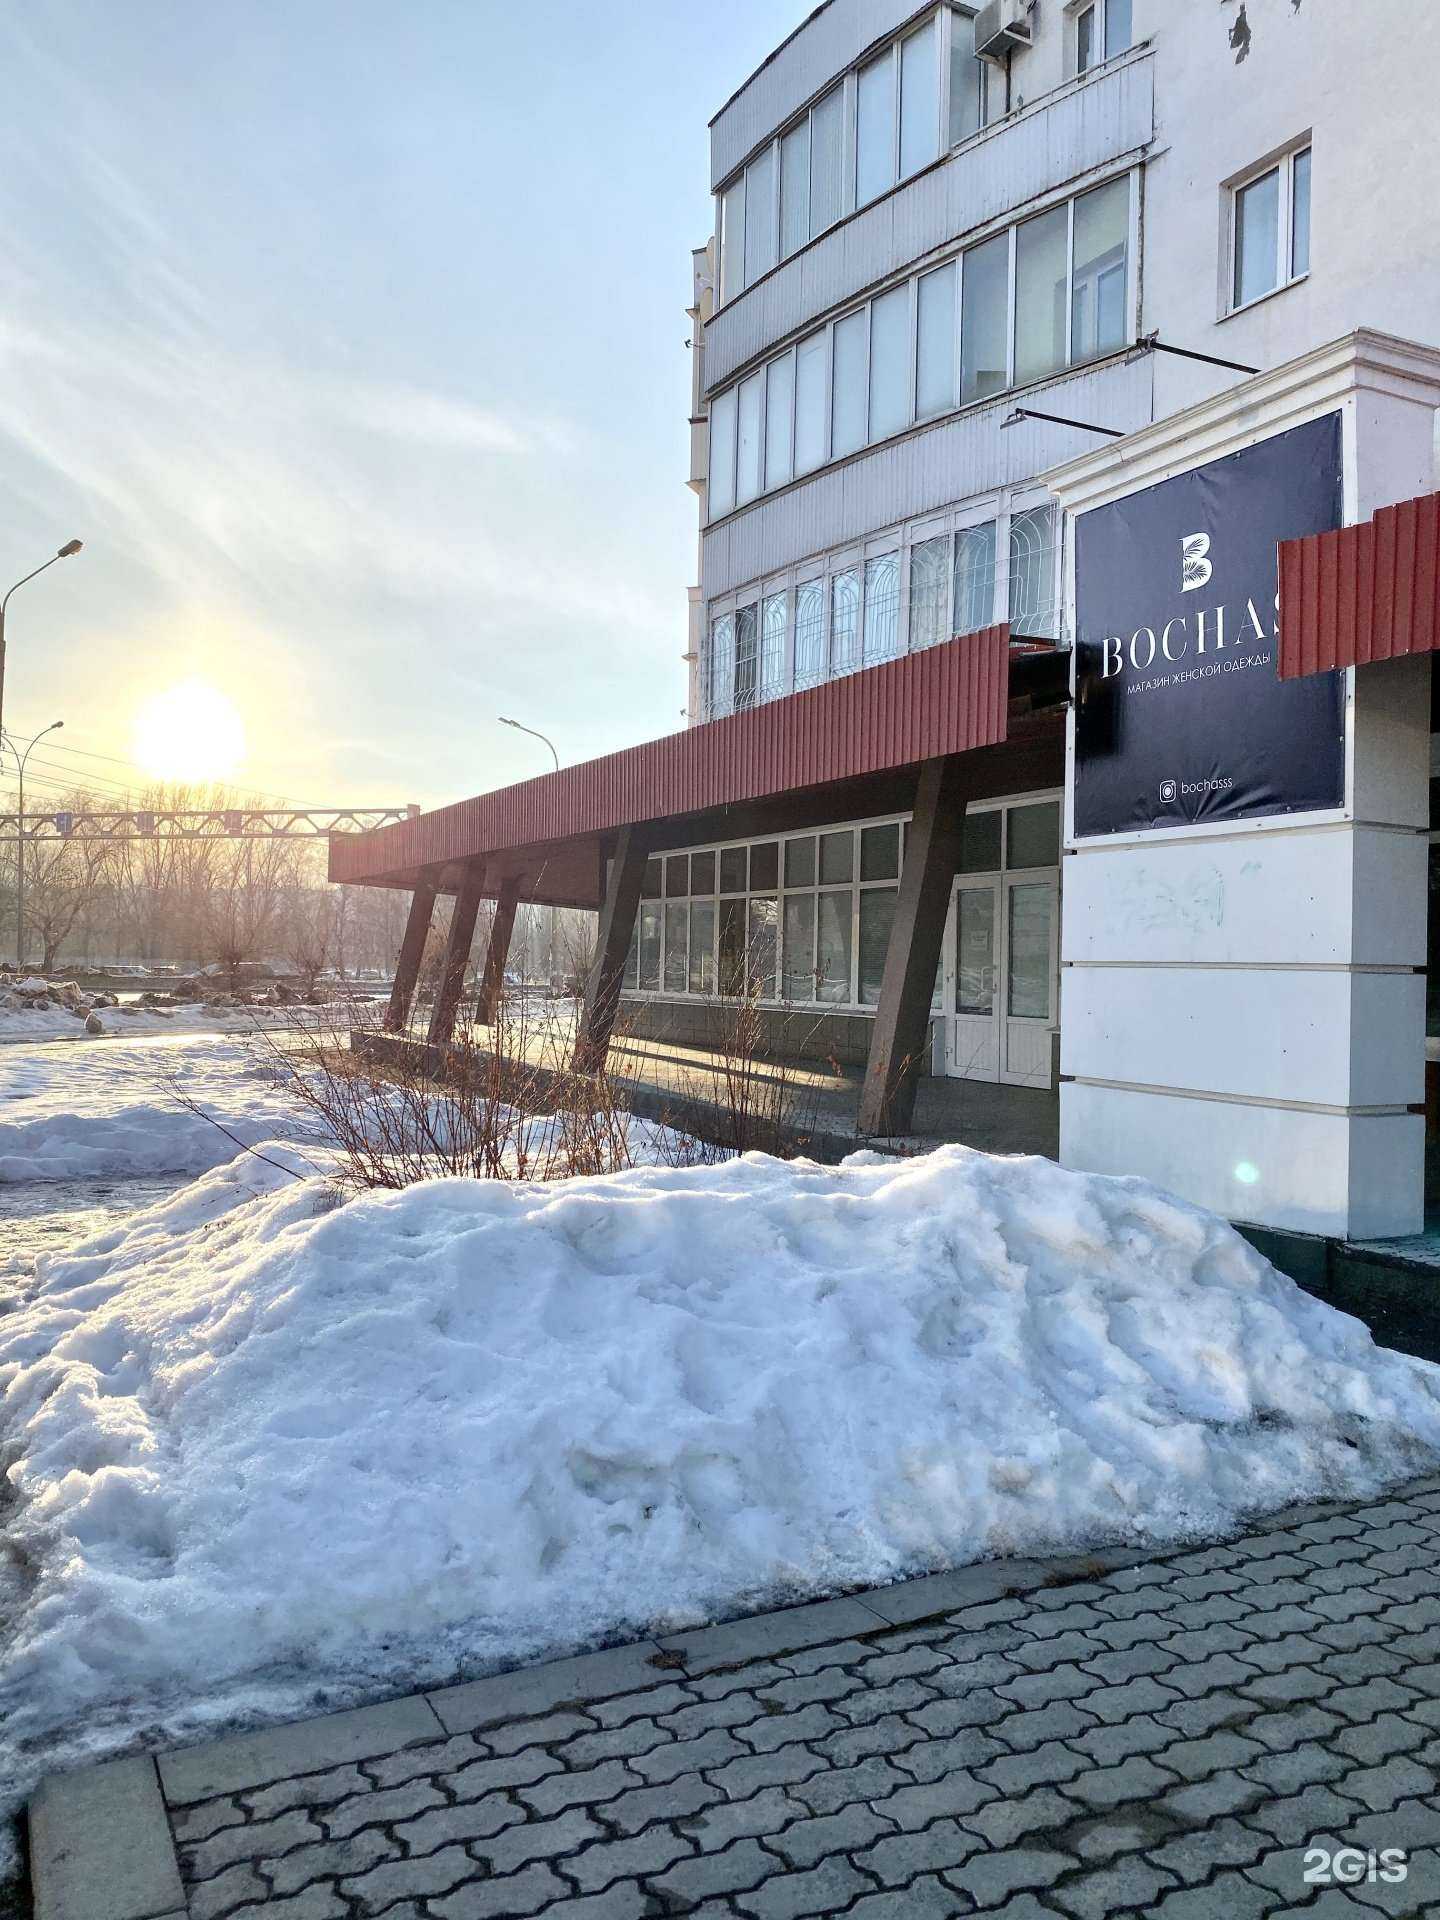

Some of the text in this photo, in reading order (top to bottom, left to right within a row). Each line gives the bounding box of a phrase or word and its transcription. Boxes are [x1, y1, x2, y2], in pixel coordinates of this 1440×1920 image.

[1179, 532, 1213, 593] B
[1127, 652, 1271, 695] МАГАЗИН ЖЕНСКОЙ ОДЕЖДЫ
[1181, 778, 1233, 794] bochasss
